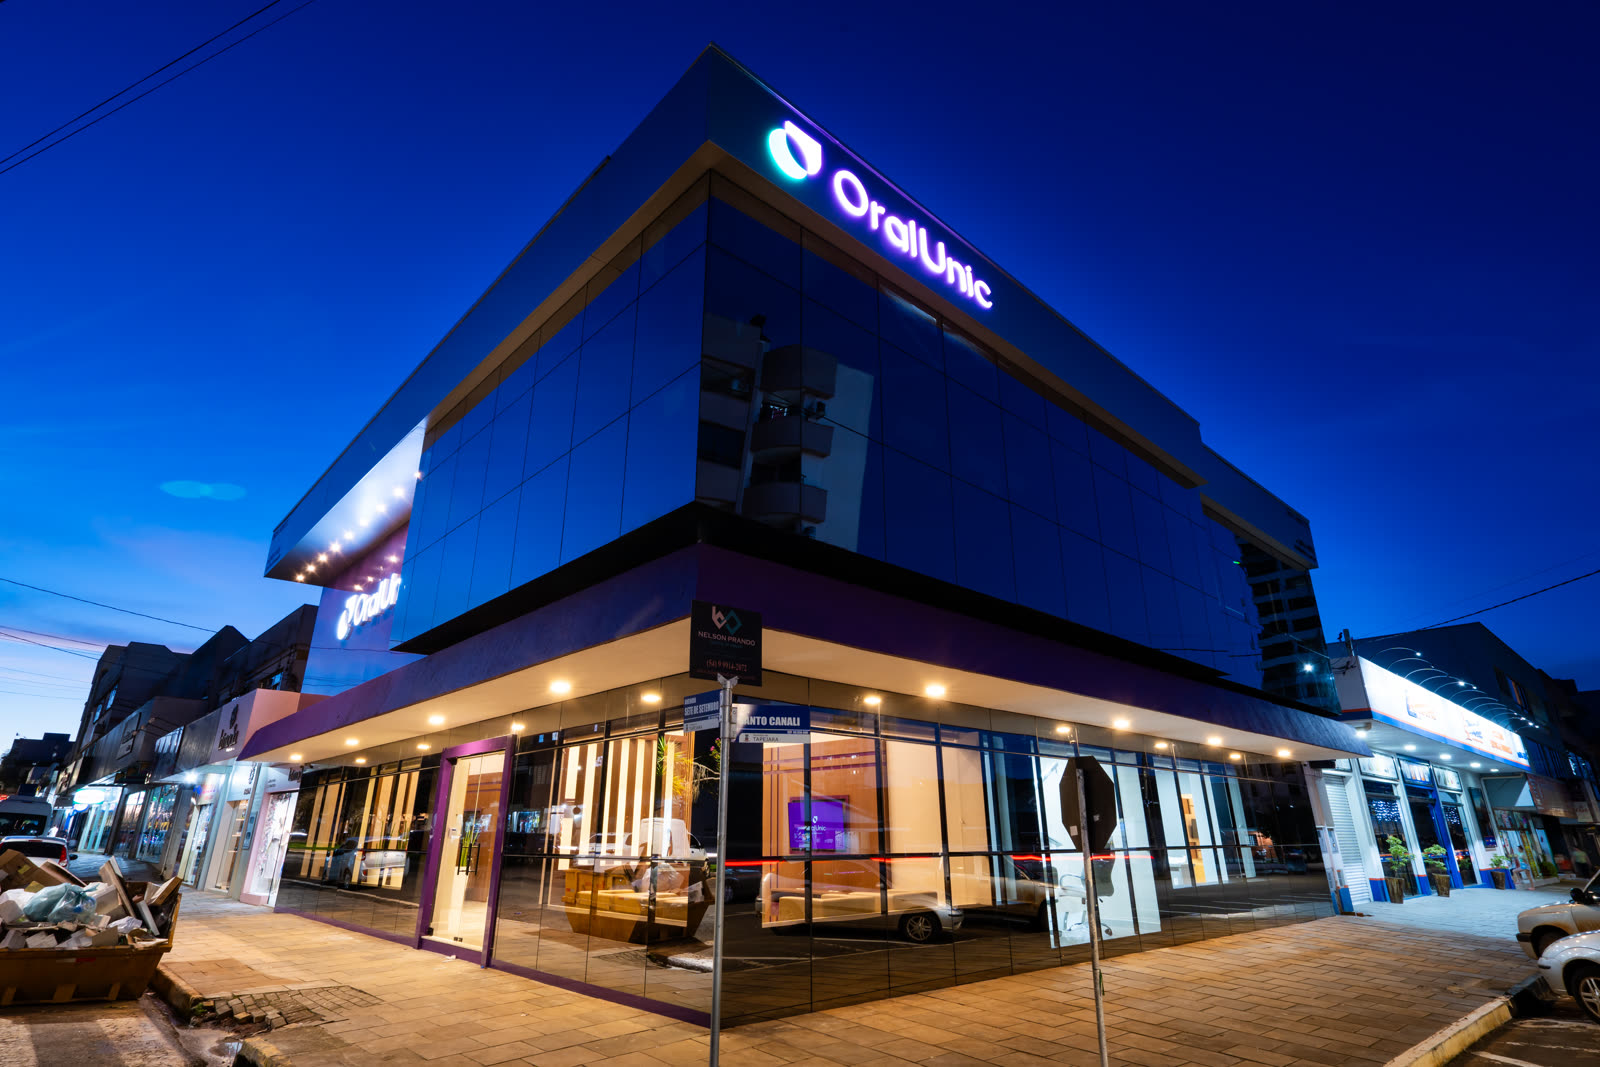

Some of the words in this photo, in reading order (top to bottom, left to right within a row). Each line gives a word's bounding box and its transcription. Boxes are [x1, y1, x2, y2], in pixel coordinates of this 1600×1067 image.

[833, 169, 993, 309] OralUnic
[698, 631, 727, 641] NELSON
[727, 636, 756, 646] PRANDO
[684, 706, 693, 716] SETE
[693, 705, 699, 714] DE
[699, 701, 719, 713] SETEMBRO
[743, 715, 768, 726] ANTO
[769, 716, 801, 727] CANALI
